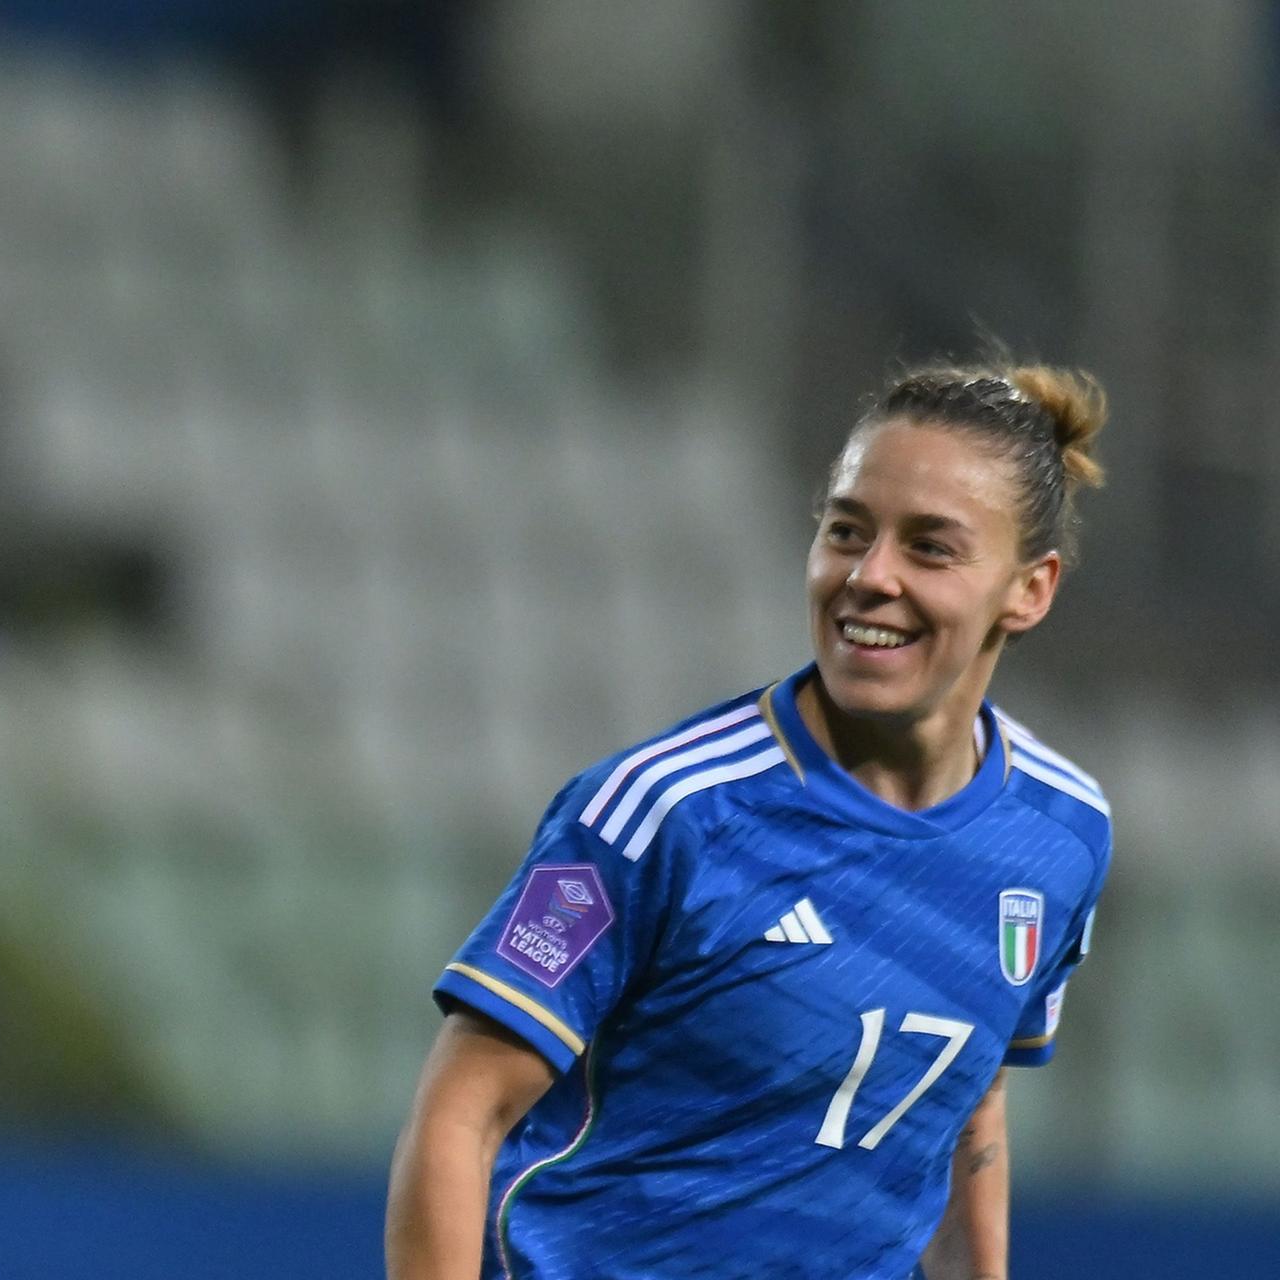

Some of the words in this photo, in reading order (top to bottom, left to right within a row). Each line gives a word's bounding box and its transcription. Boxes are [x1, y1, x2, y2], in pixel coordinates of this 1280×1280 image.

[1003, 900, 1038, 917] ITALIA
[510, 936, 559, 973] LEAGUE
[513, 924, 569, 964] NATIONS
[814, 1008, 975, 1150] 17
